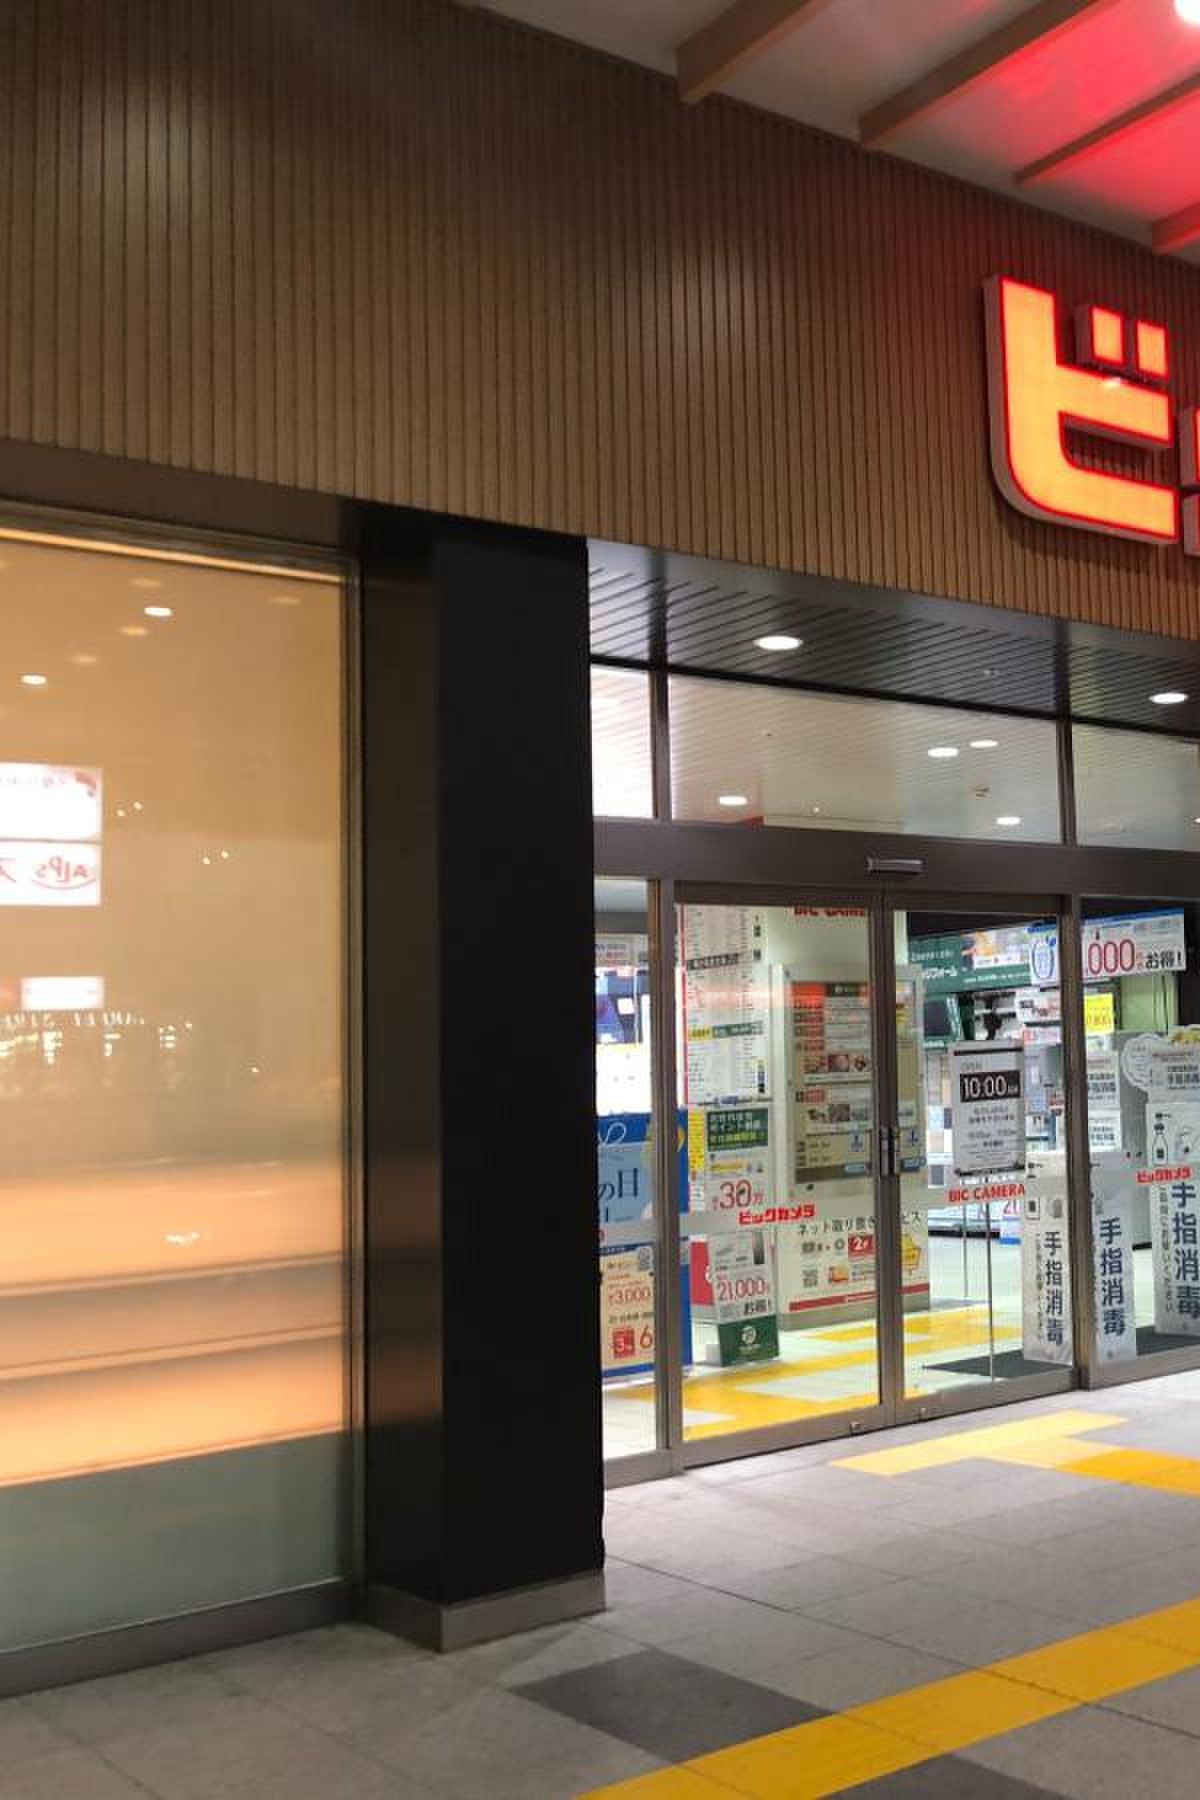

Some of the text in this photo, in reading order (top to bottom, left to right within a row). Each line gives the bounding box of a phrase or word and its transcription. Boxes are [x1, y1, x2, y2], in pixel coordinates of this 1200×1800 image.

[962, 1075, 1008, 1100] 10:00
[973, 1183, 1025, 1200] CAMERA
[738, 1204, 815, 1226] ビックカメラ
[1043, 1230, 1063, 1346] 手指消毒
[1099, 1216, 1125, 1337] 手指消毒
